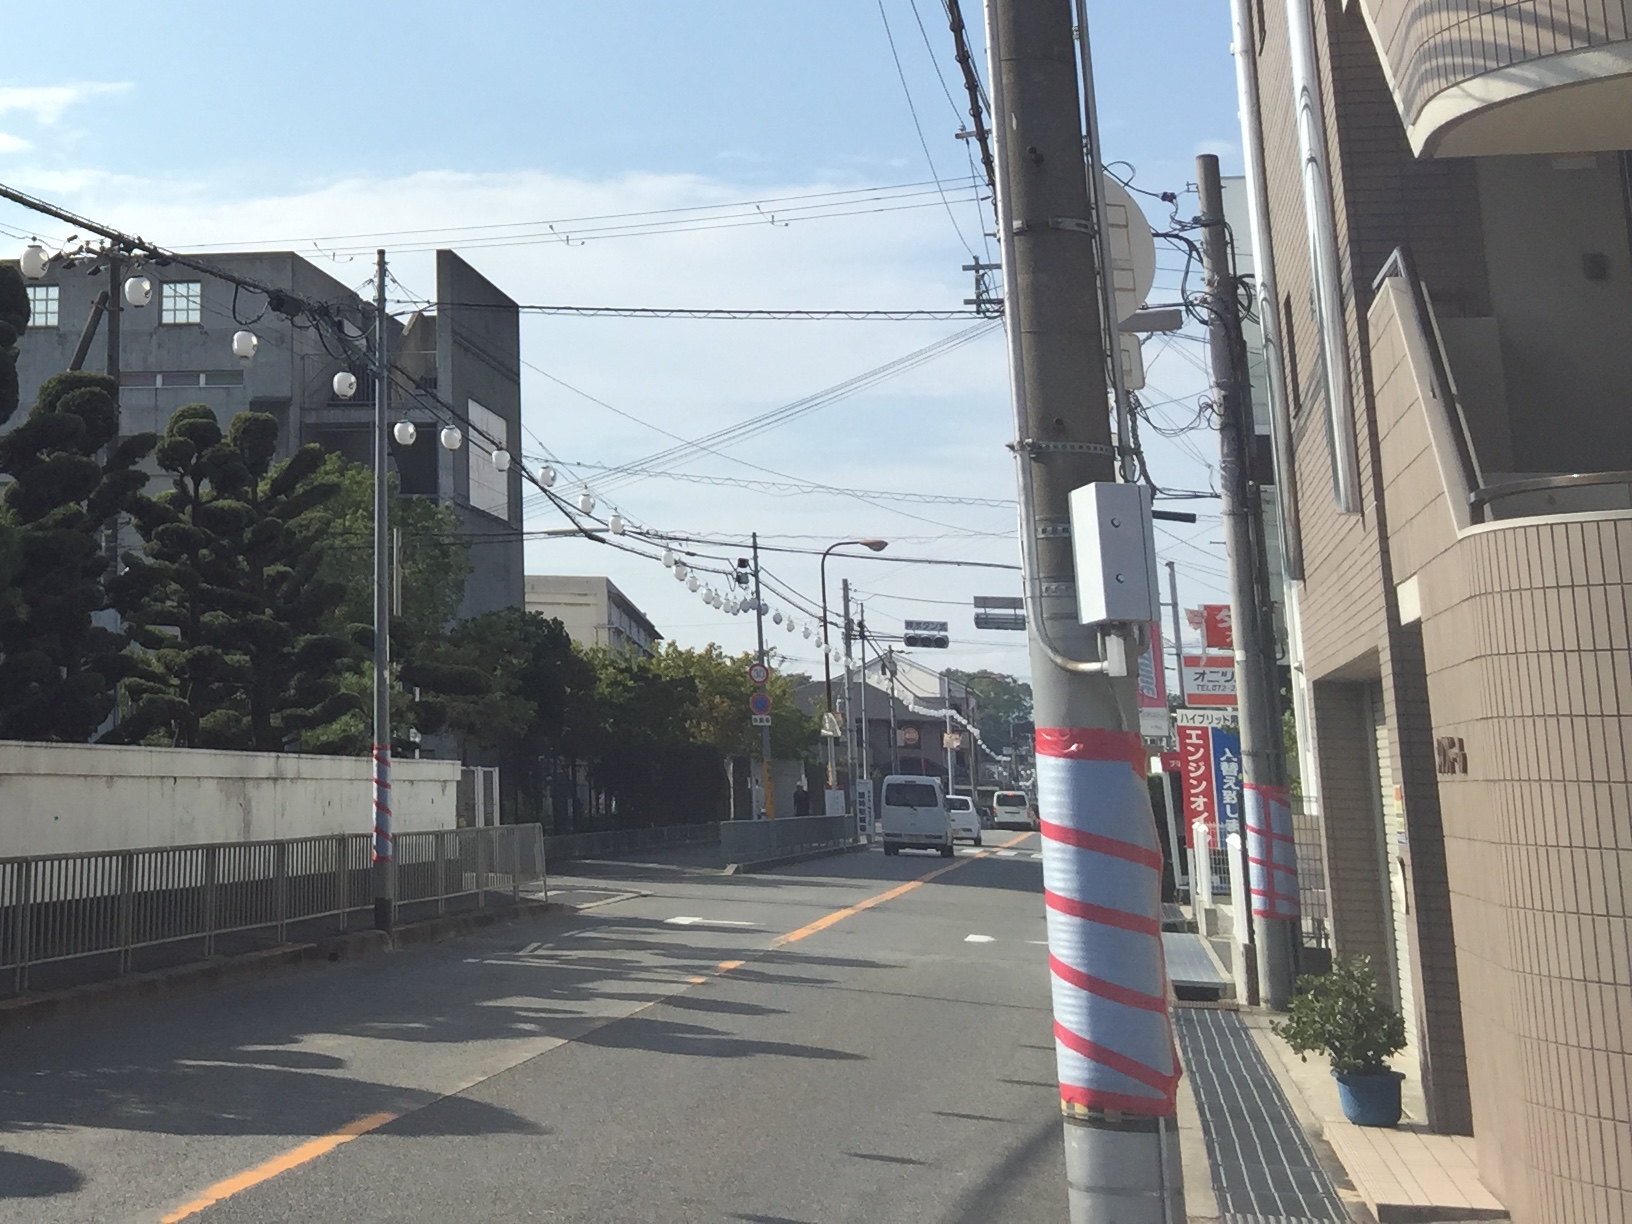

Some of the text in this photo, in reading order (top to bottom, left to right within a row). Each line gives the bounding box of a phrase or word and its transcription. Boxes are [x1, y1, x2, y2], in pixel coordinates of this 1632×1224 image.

[1193, 669, 1236, 683] オニツ
[1185, 729, 1211, 842] エンジンオイ
[1220, 747, 1241, 835] 入替え致しま
